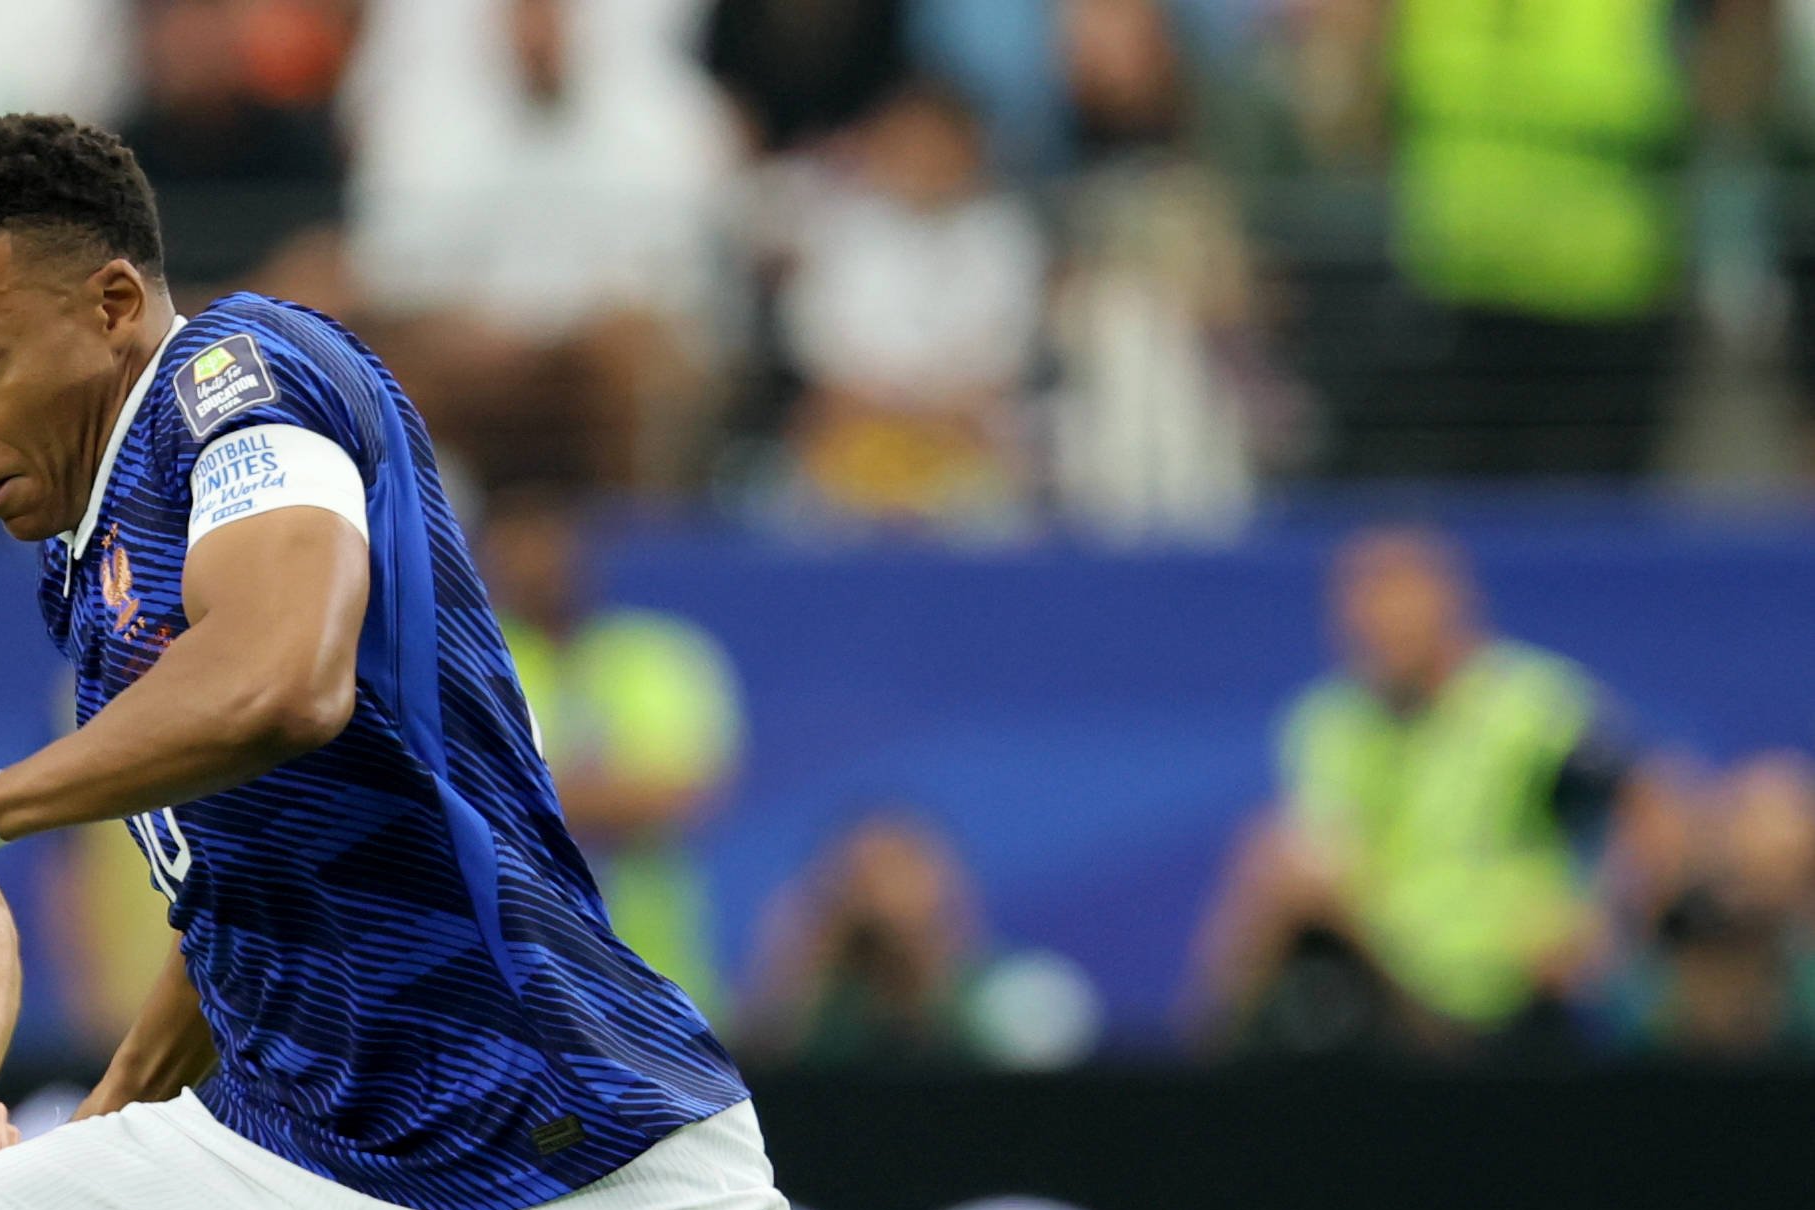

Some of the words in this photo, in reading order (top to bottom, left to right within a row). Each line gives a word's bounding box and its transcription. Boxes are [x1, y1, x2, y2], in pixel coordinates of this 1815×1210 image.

[195, 374, 259, 418] EDUCATION
[193, 433, 273, 479] FOOTBALL
[196, 451, 278, 503] UNITES
[221, 471, 286, 504] World
